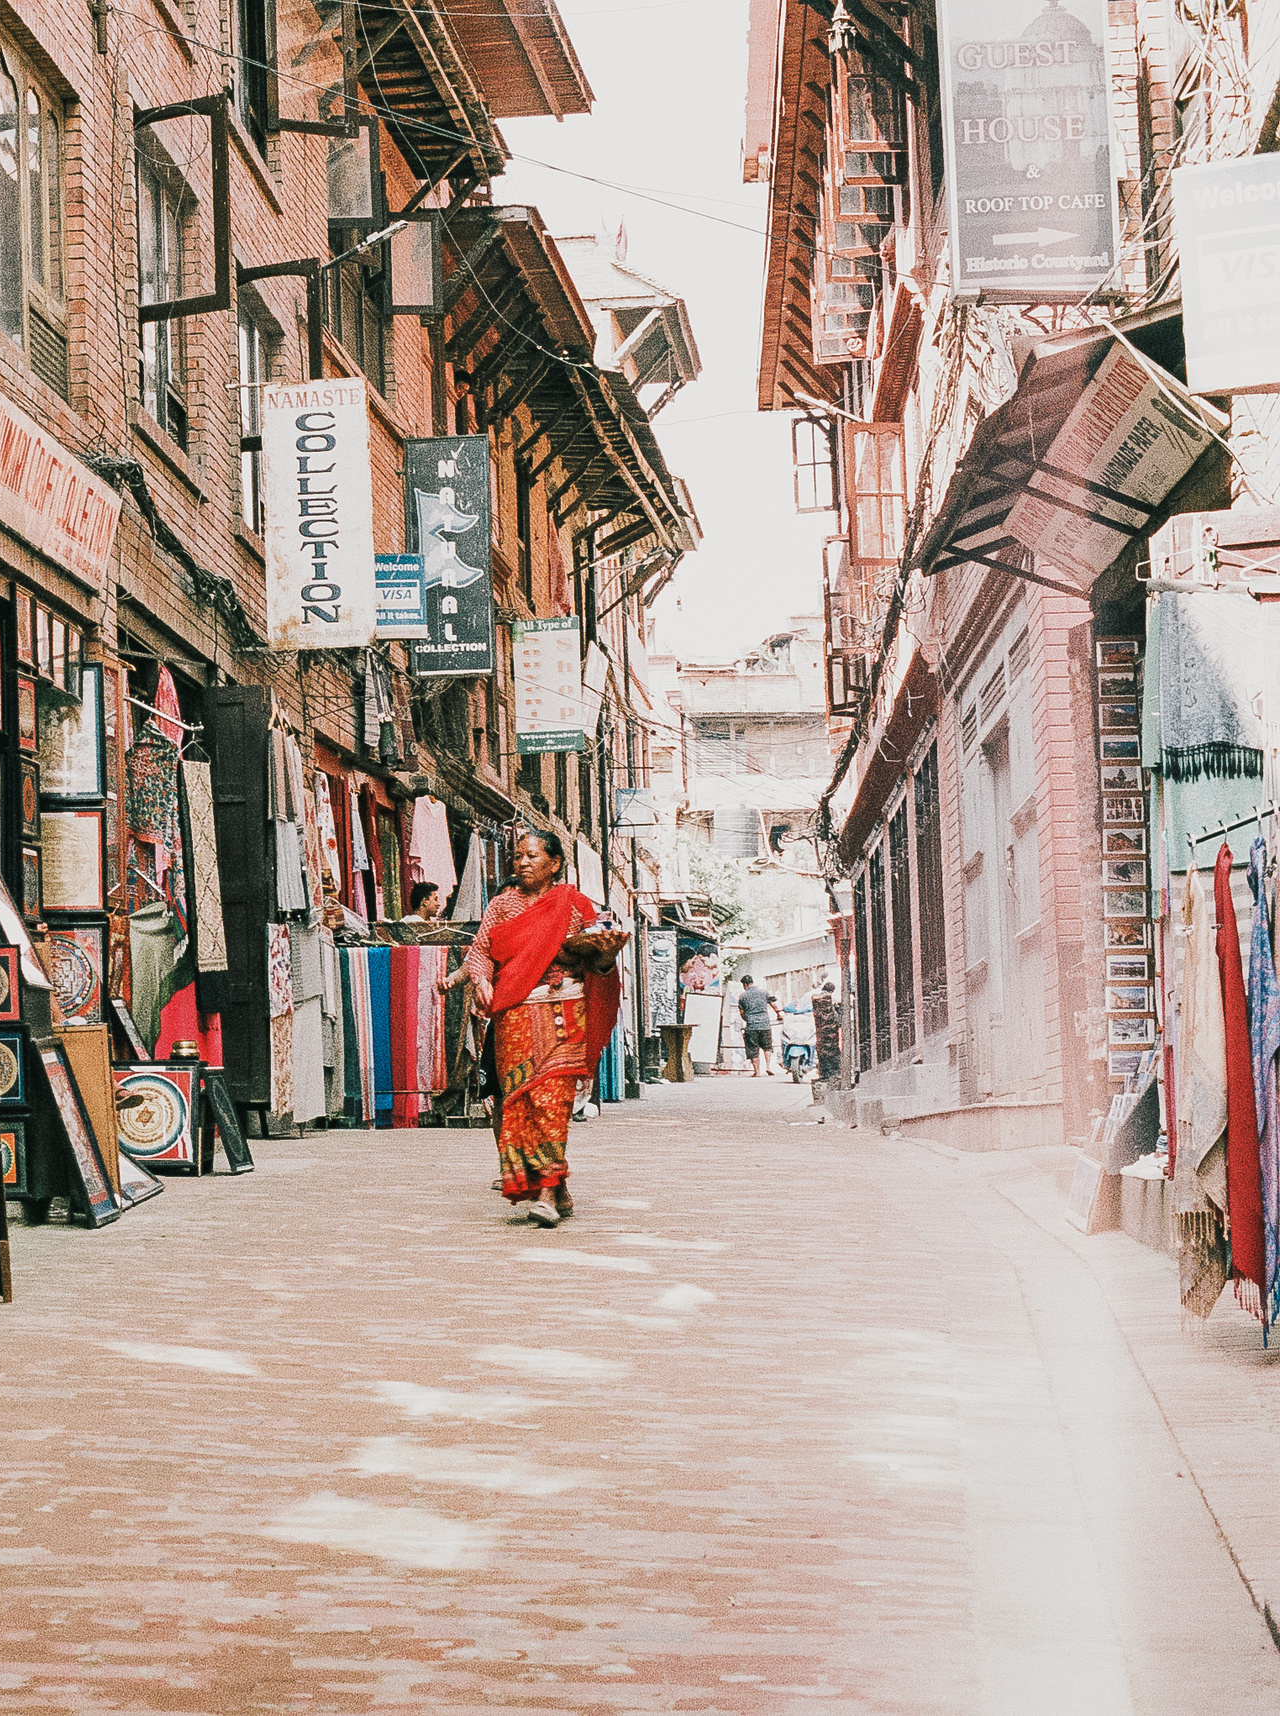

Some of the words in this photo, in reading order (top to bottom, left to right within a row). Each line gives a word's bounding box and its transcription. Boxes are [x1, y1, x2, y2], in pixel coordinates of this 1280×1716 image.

[957, 40, 1077, 70] GUEST
[961, 114, 1086, 144] HOUSE
[1026, 164, 1041, 178] &
[965, 197, 1013, 214] ROOF
[1018, 196, 1053, 211] TOP
[1058, 194, 1106, 209] CAFE
[966, 256, 1029, 272] Historic
[1031, 252, 1110, 271] Courtyard
[267, 387, 361, 410] NAMASTE
[1098, 441, 1144, 491] HANDMADE
[1133, 416, 1164, 454] PAPER
[295, 411, 342, 624] COLLECTION
[437, 459, 458, 641] NATURAL
[375, 562, 419, 572] Welcome
[382, 589, 412, 600] VISA
[388, 611, 394, 619] it
[520, 621, 534, 631] All
[537, 620, 560, 631] Type
[561, 620, 573, 629] of
[415, 642, 487, 653] COLLECTION
